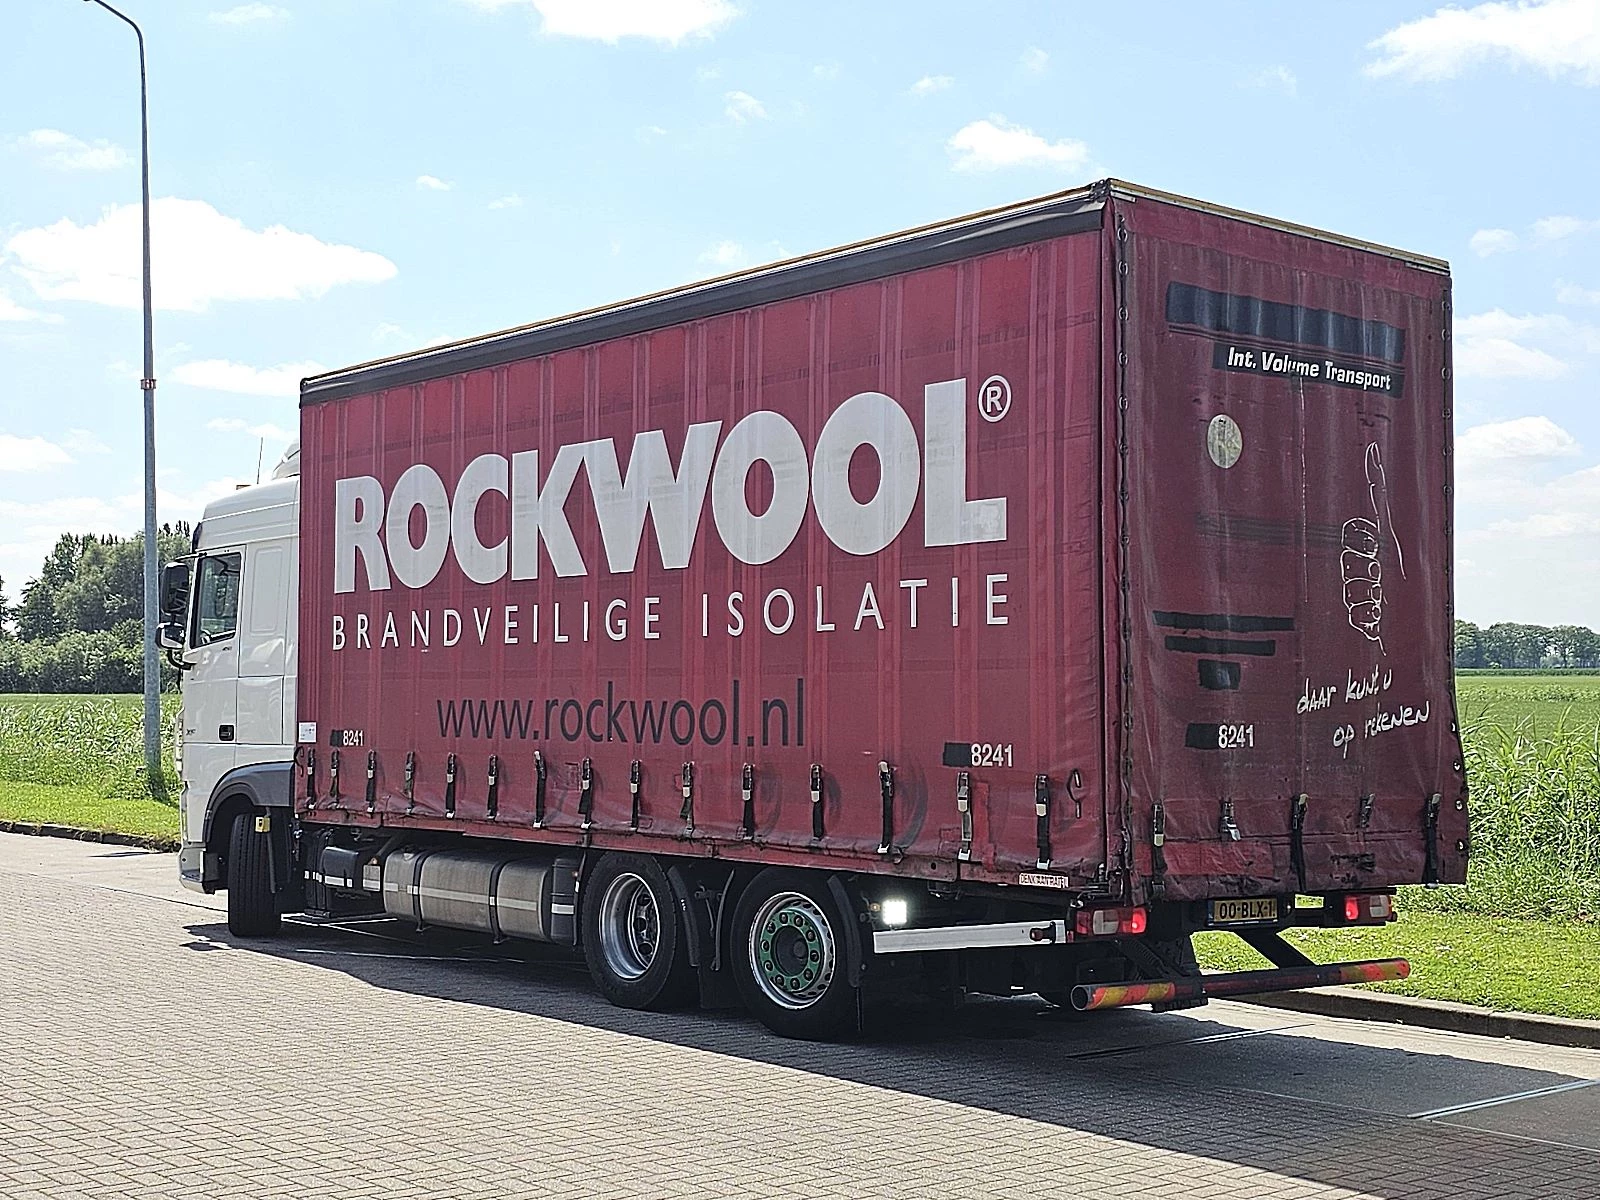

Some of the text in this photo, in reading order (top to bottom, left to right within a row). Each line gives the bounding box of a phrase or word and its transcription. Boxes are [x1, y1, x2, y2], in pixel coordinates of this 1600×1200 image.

[1227, 346, 1391, 391] Int. Volume Transport
[333, 377, 1008, 595] ROCKWOOL
[332, 573, 1009, 651] BRANDVEILIGE ISOLATIE
[436, 677, 805, 747] www.rockwool.nl
[342, 729, 364, 747] 8241
[970, 743, 1014, 768] 8241
[1218, 724, 1255, 749] 8241
[1333, 724, 1355, 760] op
